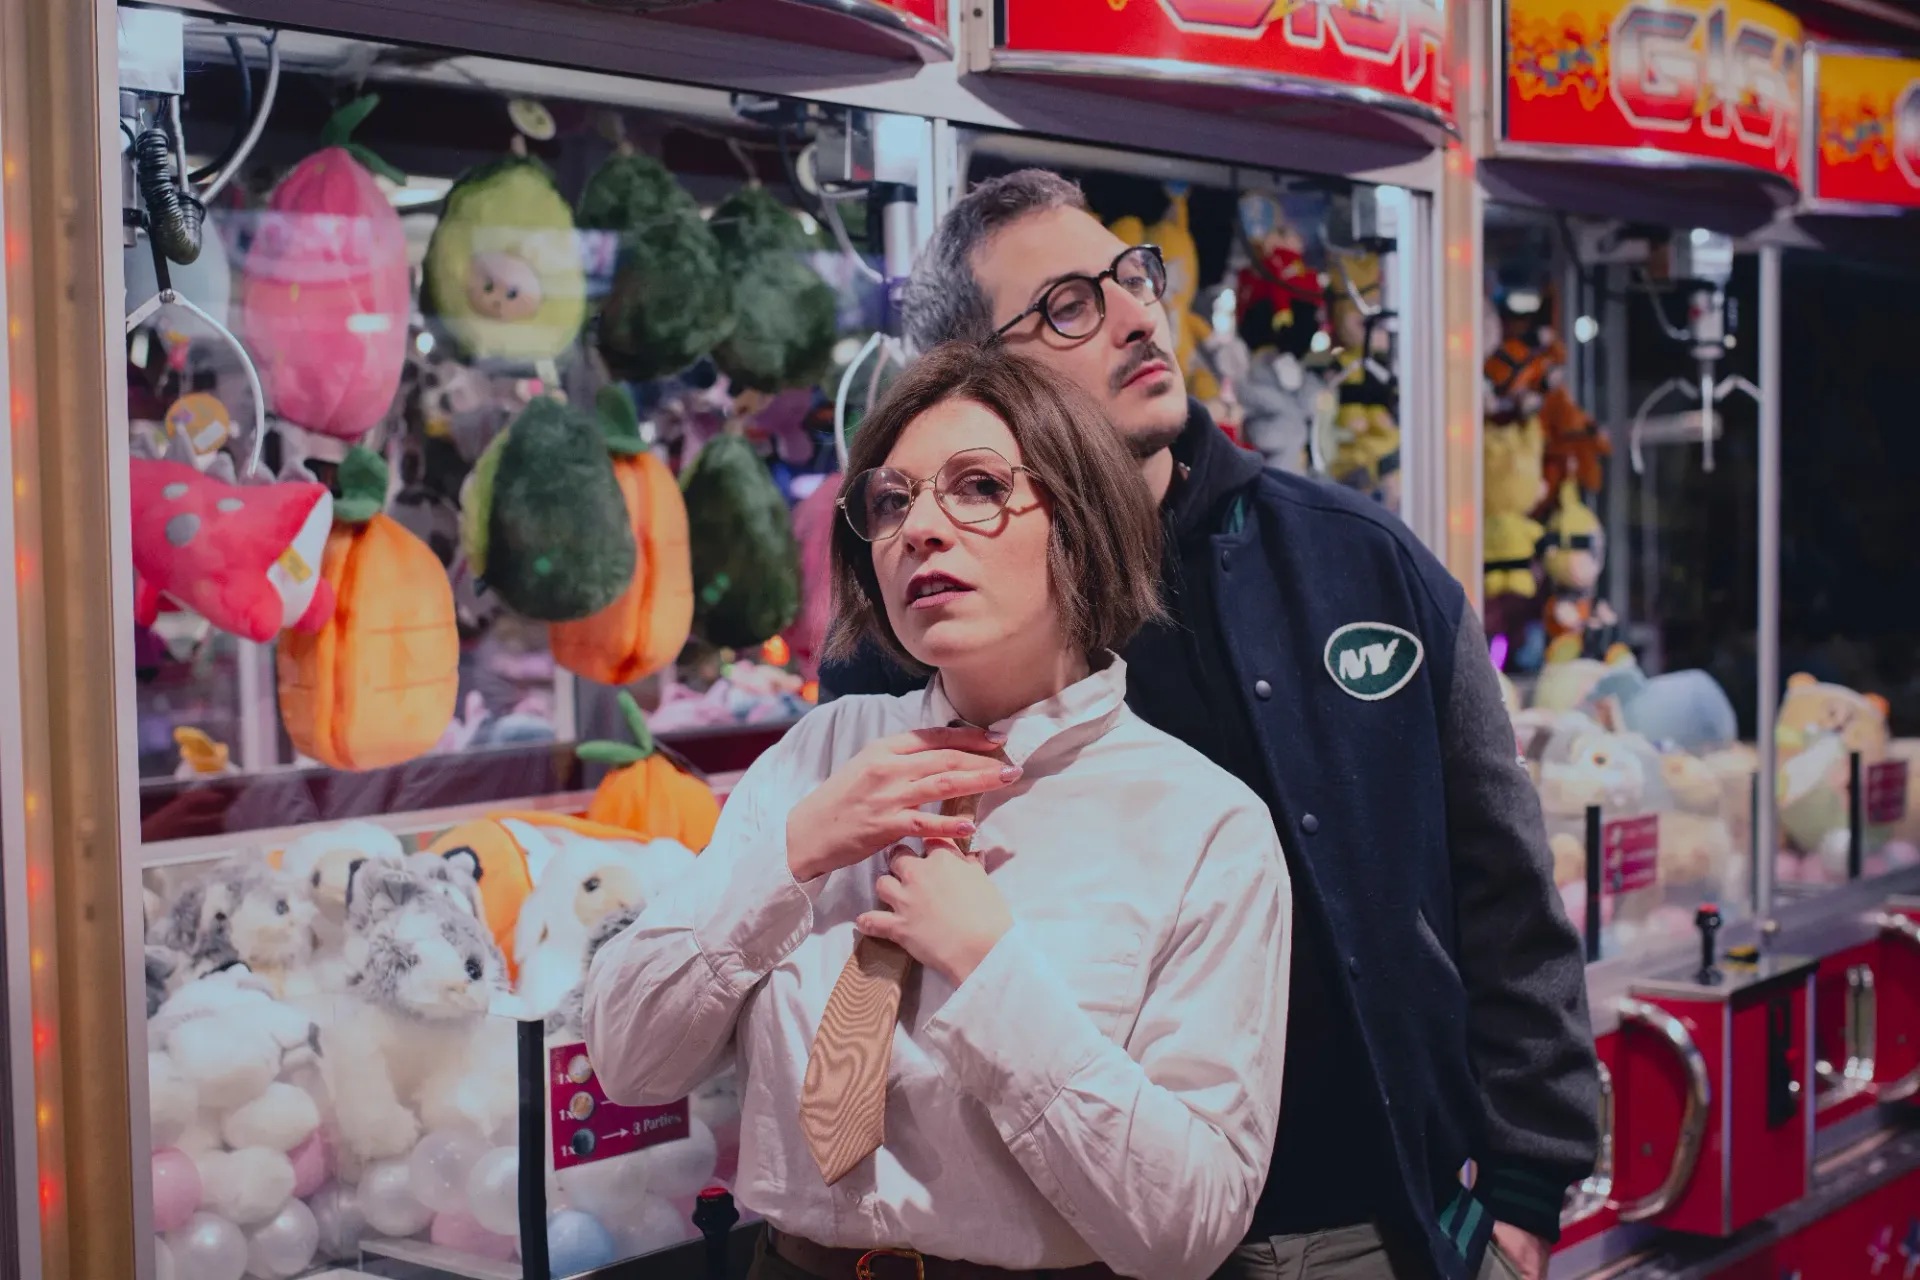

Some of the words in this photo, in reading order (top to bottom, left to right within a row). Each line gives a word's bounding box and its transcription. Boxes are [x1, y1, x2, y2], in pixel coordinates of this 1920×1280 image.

[1339, 638, 1400, 680] NY
[632, 1121, 642, 1136] 3
[643, 1112, 682, 1133] Parties
